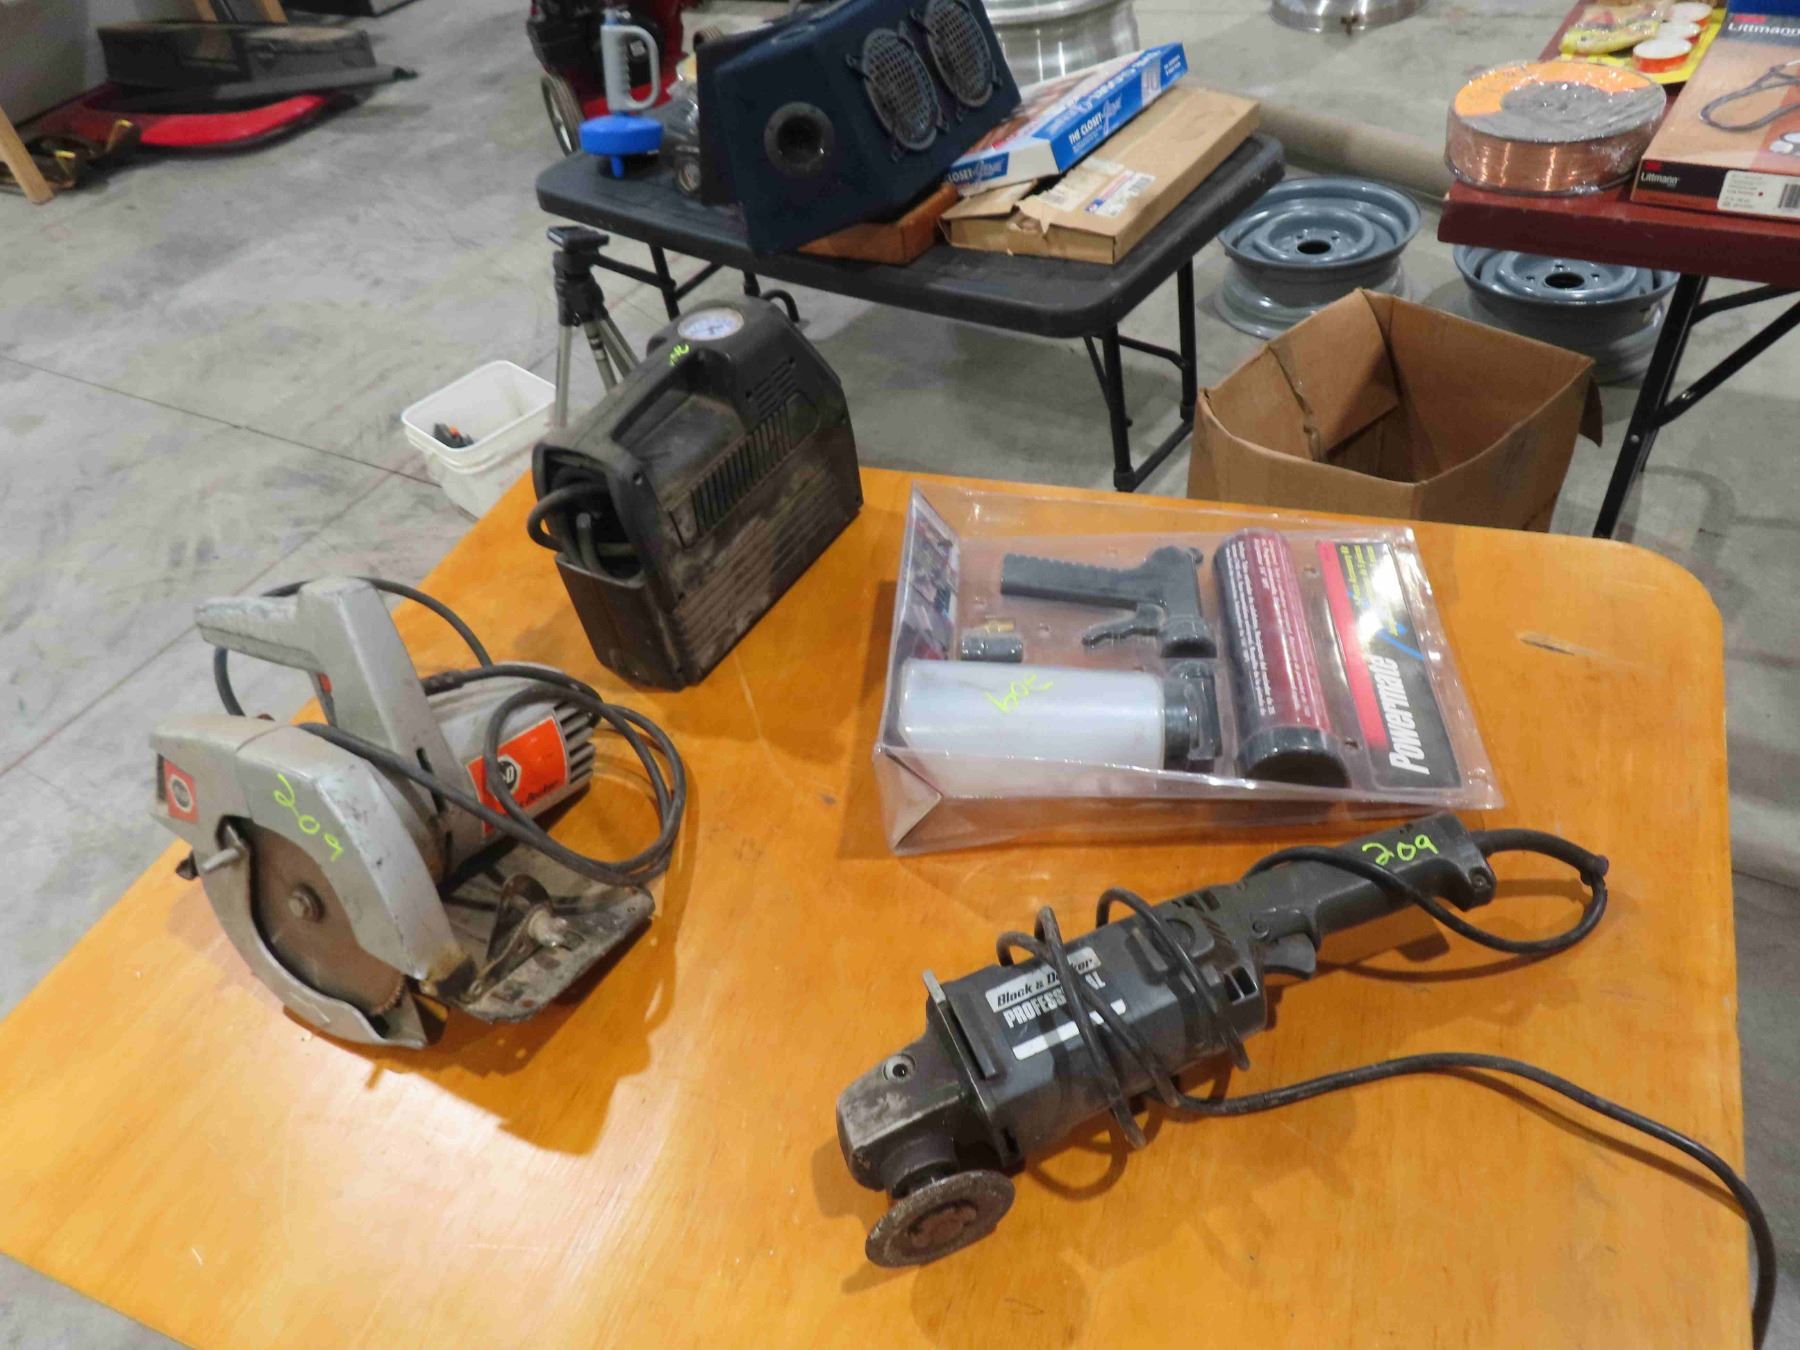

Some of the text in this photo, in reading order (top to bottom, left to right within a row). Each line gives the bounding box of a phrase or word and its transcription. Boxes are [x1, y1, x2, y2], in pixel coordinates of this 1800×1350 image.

[1366, 653, 1430, 775] Powermate
[273, 772, 344, 862] 209
[1361, 834, 1439, 866] 209
[997, 982, 1033, 1009] Black
